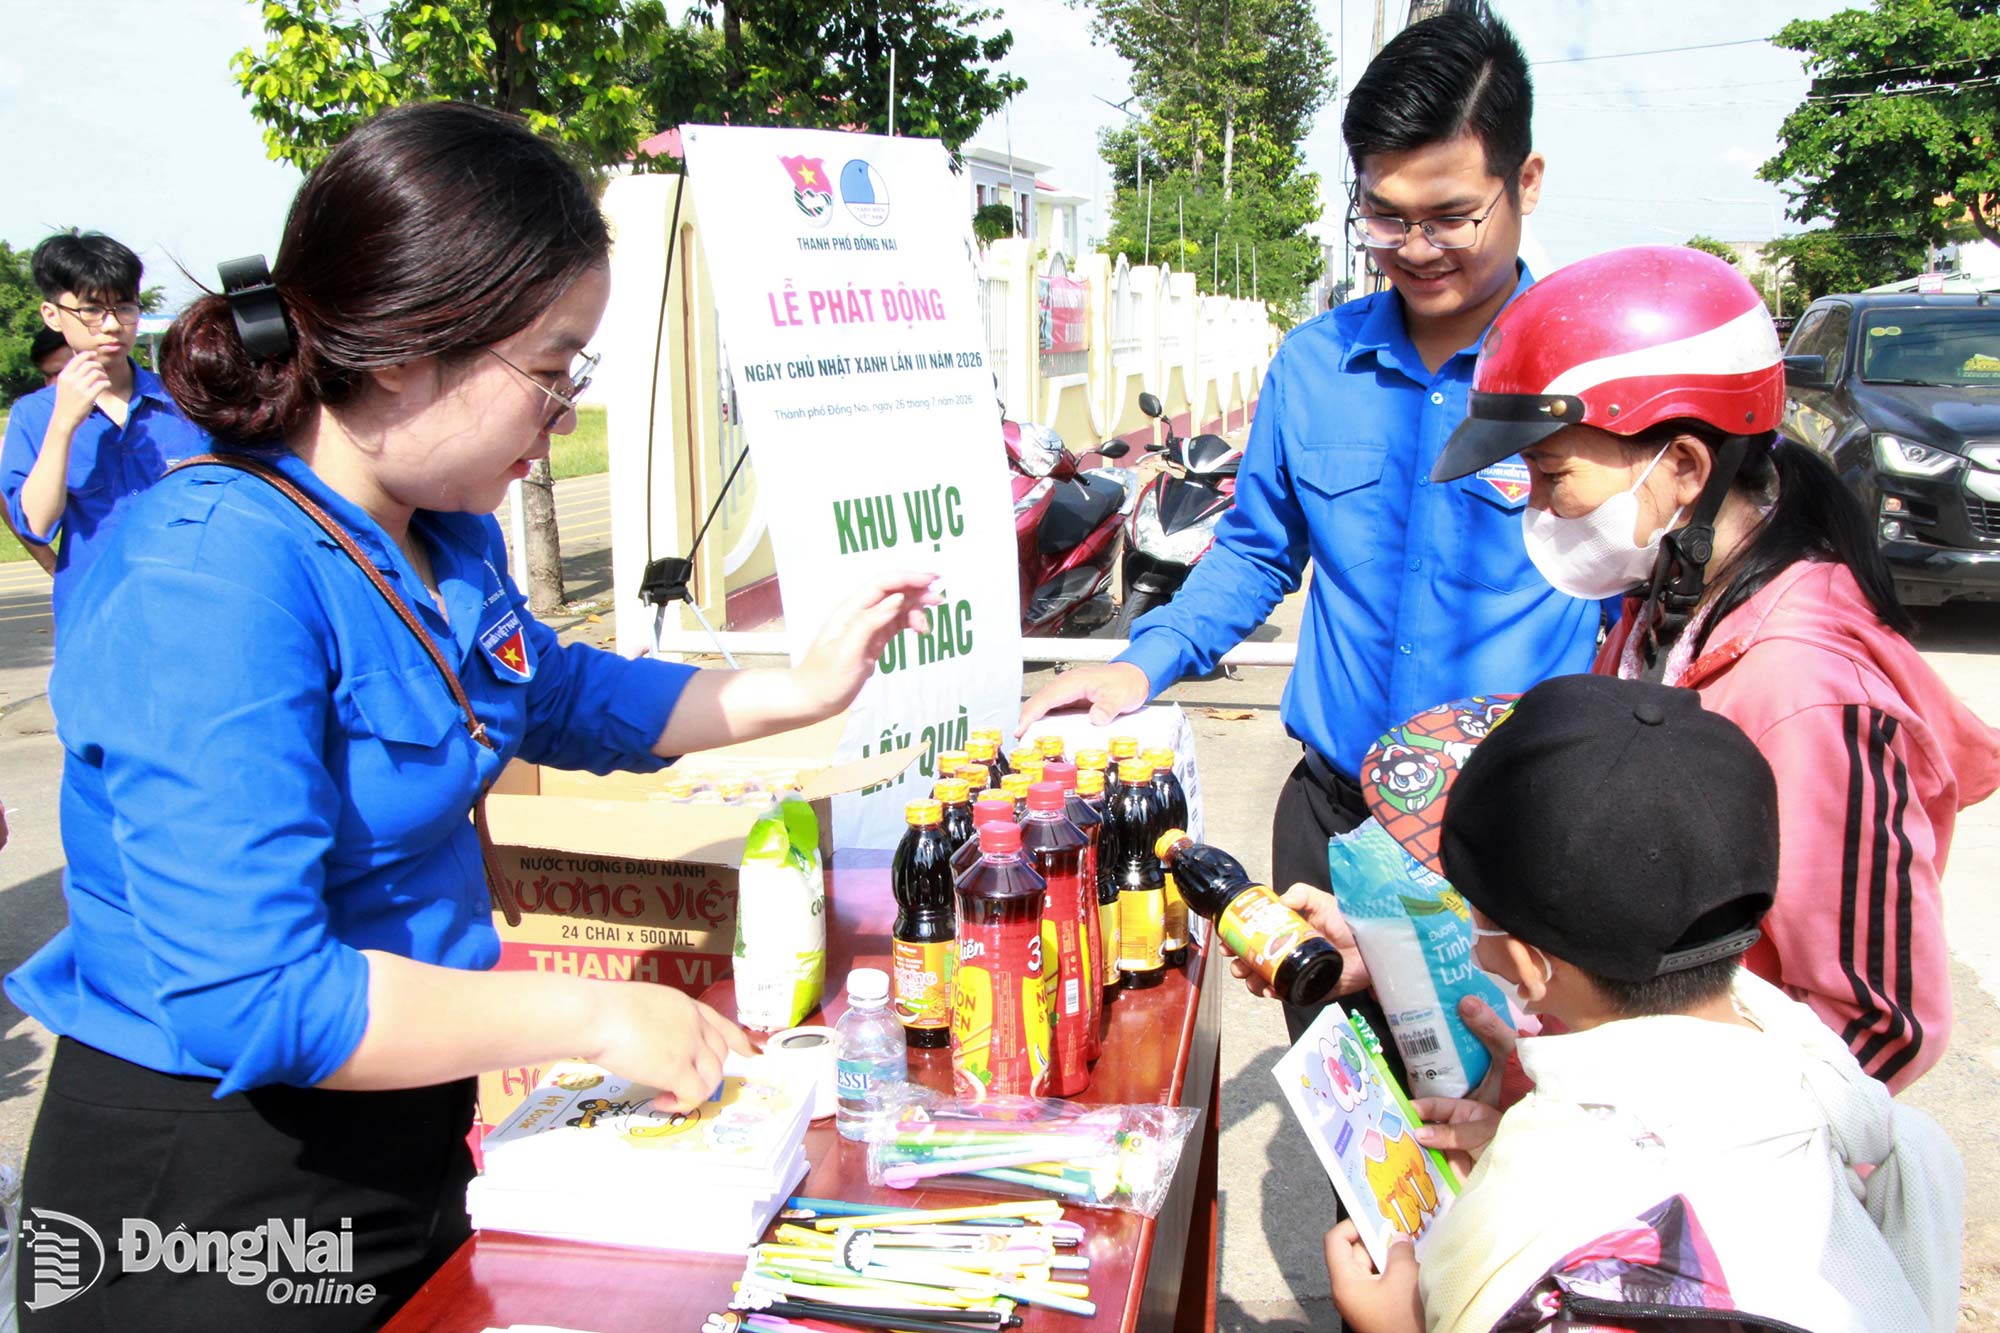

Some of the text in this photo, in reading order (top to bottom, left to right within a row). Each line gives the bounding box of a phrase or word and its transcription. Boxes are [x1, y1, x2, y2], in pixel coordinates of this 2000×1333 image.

[881, 238, 898, 251] NAI
[768, 278, 946, 329] LỄ PHÁT ĐỘNG
[787, 354, 815, 378] CHỦ
[818, 354, 851, 380] NHẬT
[854, 355, 889, 374] XANH
[915, 353, 927, 370] III
[956, 351, 983, 369] 2026
[833, 483, 964, 555] KHU VỰC
[520, 856, 706, 879] NƯỚC TƯƠNG ĐẬU NÀNH
[561, 925, 695, 947] 24 CHAI x 500ML
[1433, 934, 1471, 963] Tinh
[529, 949, 659, 981] THANH
[1440, 960, 1474, 986] Luy
